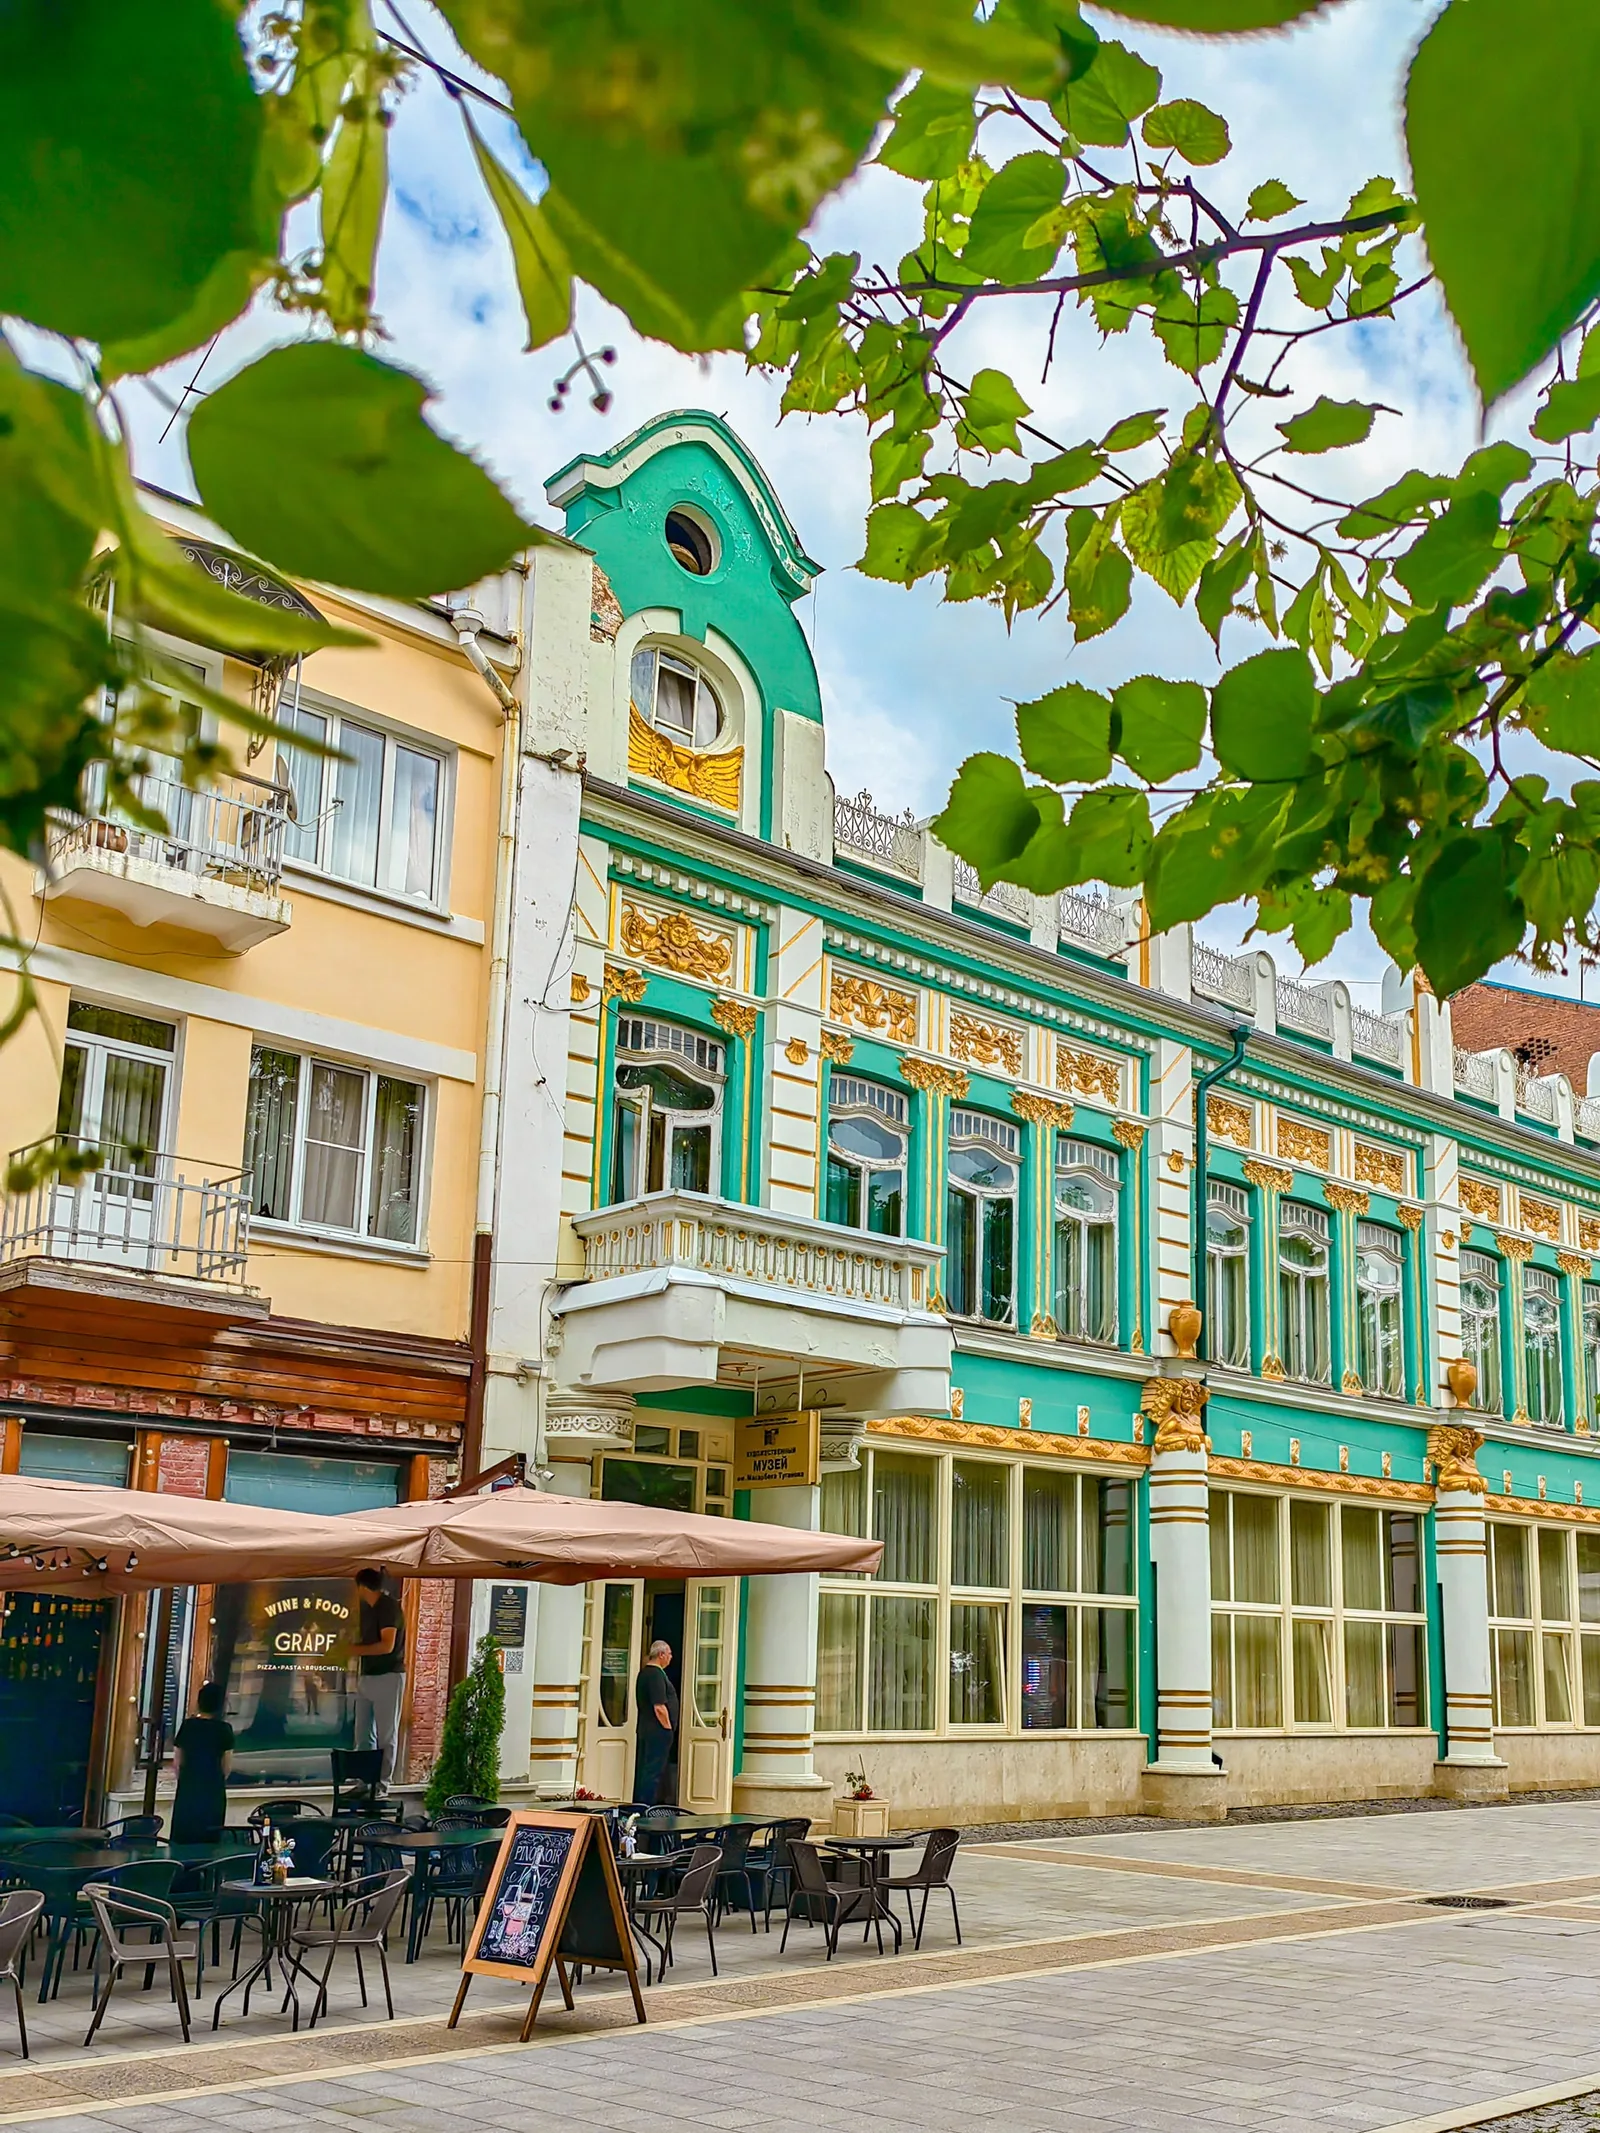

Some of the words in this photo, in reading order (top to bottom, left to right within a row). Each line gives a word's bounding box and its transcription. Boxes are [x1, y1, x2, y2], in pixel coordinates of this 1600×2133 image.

[753, 1455, 788, 1472] МУЗЕЙ
[264, 1597, 299, 1618] WINE
[303, 1598, 311, 1609] &
[315, 1598, 349, 1619] FOOD
[514, 1845, 540, 1862] PINO
